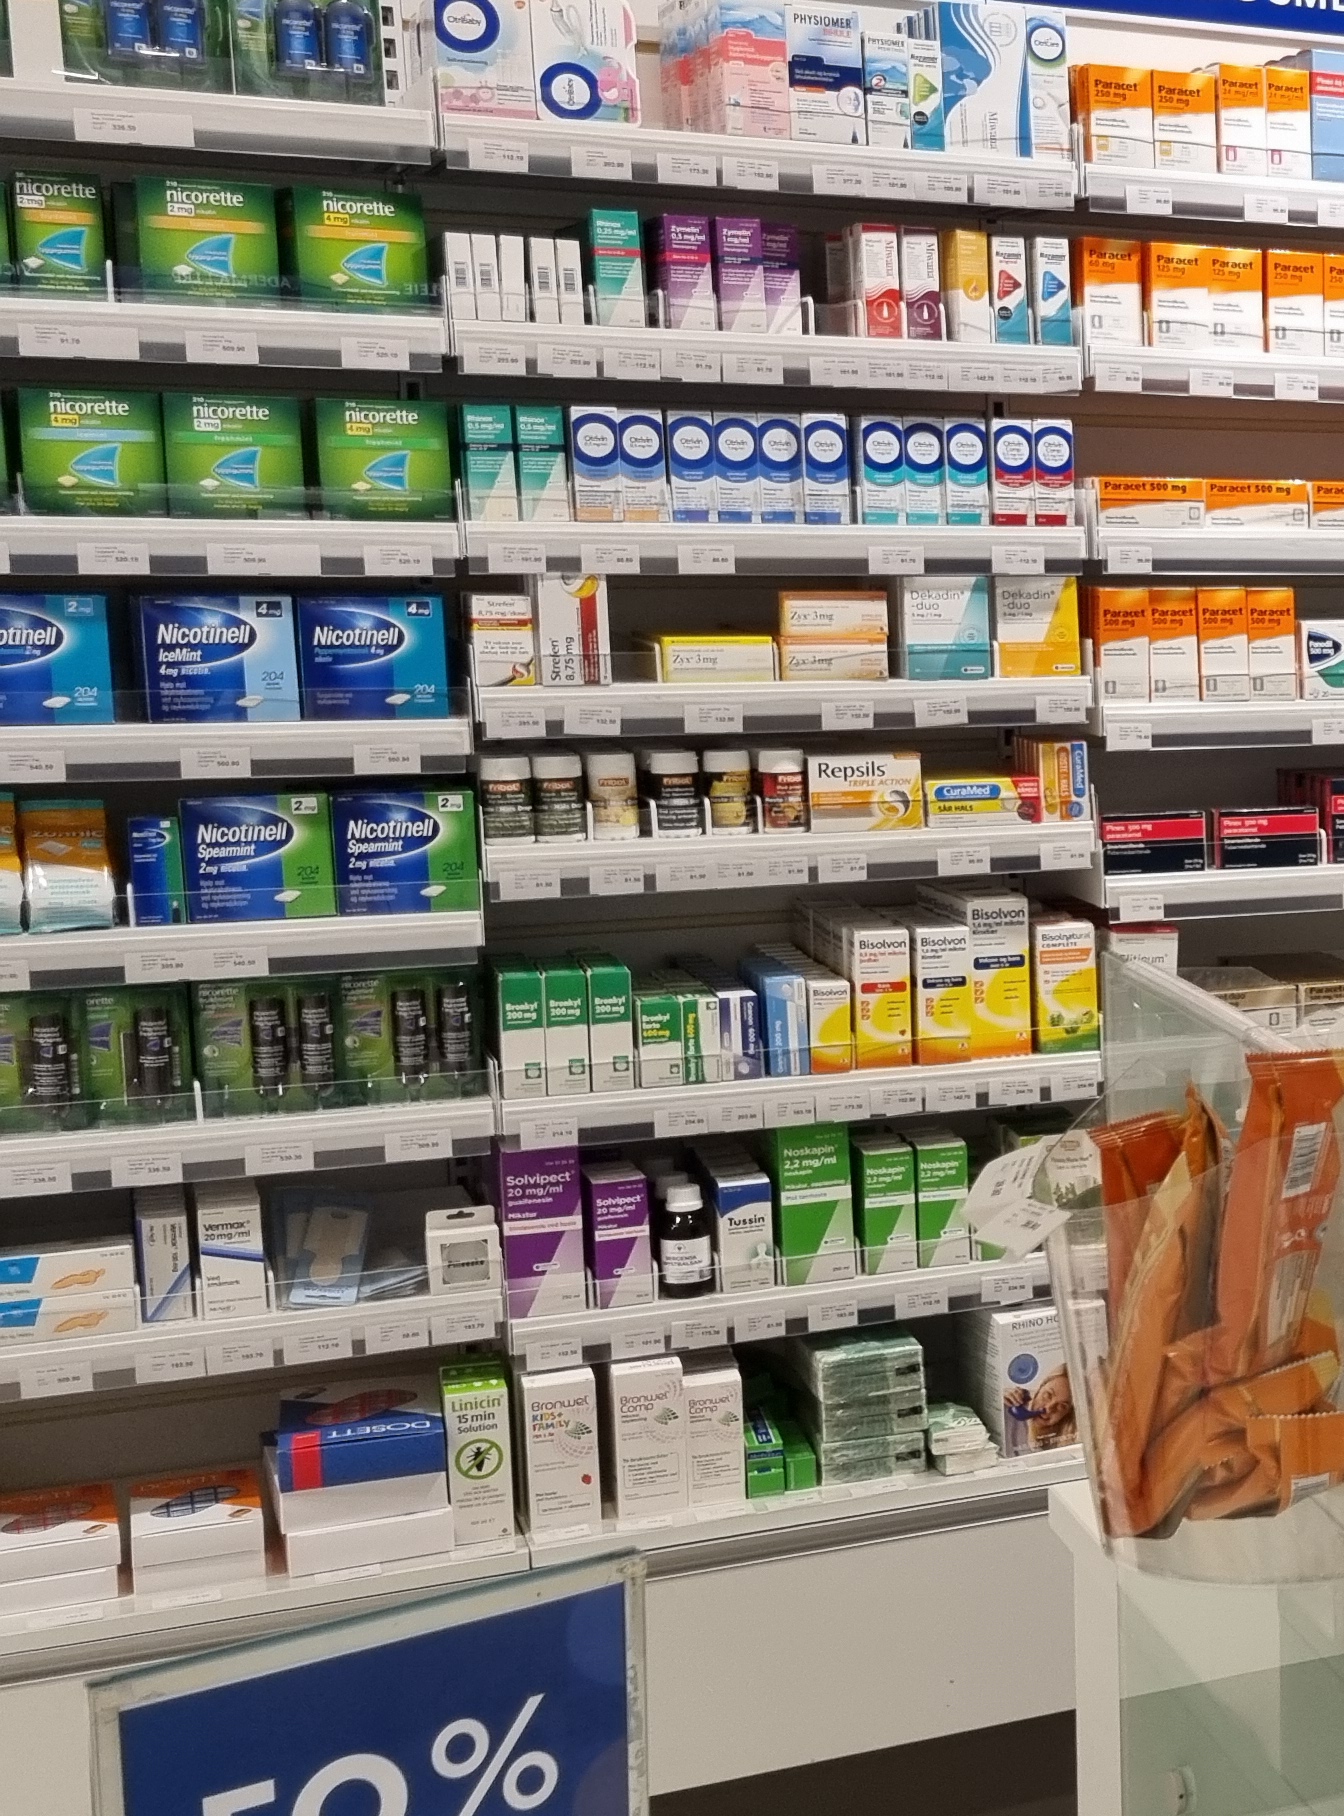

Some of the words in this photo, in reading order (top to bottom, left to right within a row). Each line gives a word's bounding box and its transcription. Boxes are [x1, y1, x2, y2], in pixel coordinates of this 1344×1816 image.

[793, 13, 851, 29] PHYSIOMER
[1094, 79, 1138, 92] Paracet
[1157, 85, 1201, 98] Paracet
[1094, 89, 1110, 99] 250
[1112, 92, 1127, 101] mg
[1158, 95, 1174, 104] 250
[1176, 98, 1190, 107] mg
[15, 180, 96, 200] nicorette
[166, 188, 244, 208] nicorette
[322, 198, 395, 218] nicorette
[1088, 249, 1132, 262] Paracet
[1156, 254, 1200, 268] Paracet
[49, 399, 129, 417] nicorette
[910, 588, 965, 601] Dekadin
[1001, 588, 1056, 601] Dekadin
[157, 623, 250, 645] Nicotinell
[313, 626, 398, 646] Nicotinell
[159, 648, 202, 663] IceMint
[551, 639, 561, 681] Strefen
[261, 671, 284, 682] 204
[414, 684, 435, 694] 204
[818, 762, 886, 782] Repsils
[1075, 750, 1083, 789] CuraMed
[849, 779, 875, 787] TRIPLE
[877, 778, 911, 786] ACTION
[943, 785, 990, 796] CuraMed
[955, 804, 973, 812] HALS
[197, 822, 287, 845] Nicotinell
[347, 817, 434, 841] Nicotinell
[198, 844, 255, 859] Spearmint
[348, 840, 403, 854] Spearmint
[972, 908, 1024, 921] Bisolvon
[858, 938, 908, 951] Bisolvon
[921, 936, 966, 948] Bisolvon
[505, 1002, 538, 1012] Bronkyl
[783, 1145, 835, 1157] Noskapin
[784, 1157, 796, 1169] 2,2
[798, 1156, 837, 1168] mg/ml
[506, 1171, 571, 1187] Solvipect
[507, 1188, 522, 1198] 20
[525, 1184, 563, 1198] mg/ml
[596, 1195, 641, 1207] Solvipect
[203, 1220, 247, 1234] Vermox
[727, 1214, 765, 1227] Tussin
[1012, 1318, 1039, 1331] RHINO
[531, 1395, 589, 1412] Bronwel
[619, 1391, 669, 1405] Bronwel
[451, 1397, 501, 1413] Linicin
[620, 1402, 654, 1414] Comp
[457, 1412, 470, 1423] 15
[471, 1411, 495, 1422] min
[327, 1419, 430, 1440] DOSETT
[457, 1422, 498, 1434] Solution
[532, 1419, 570, 1432] FAMILY
